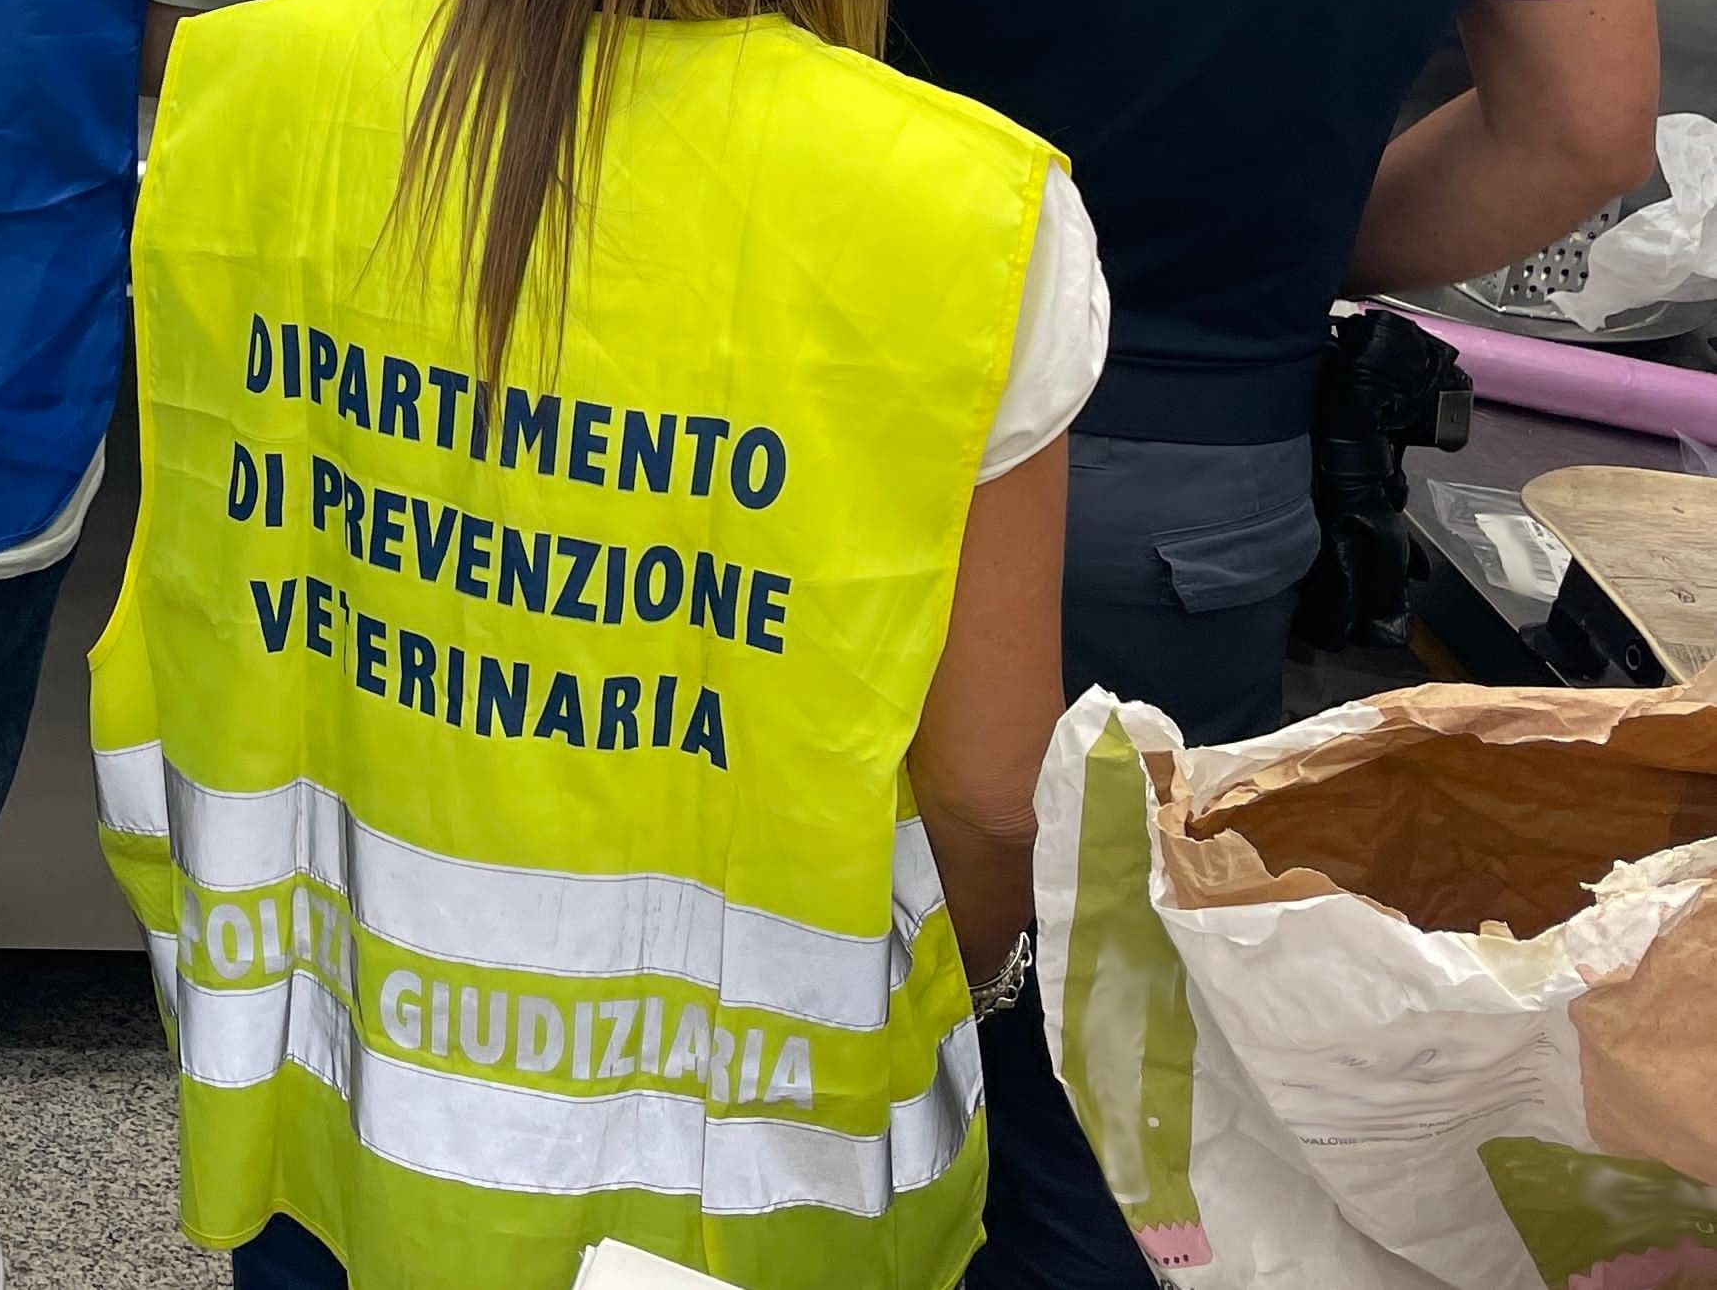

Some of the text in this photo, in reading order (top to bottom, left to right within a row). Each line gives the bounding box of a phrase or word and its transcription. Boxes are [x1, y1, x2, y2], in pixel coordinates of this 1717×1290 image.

[245, 312, 787, 510] DIPARTIMENTO
[227, 440, 792, 655] DI PREVENZIONE
[249, 575, 729, 771] VEERINARIA
[379, 970, 815, 1111] GIUDIZIARIA
